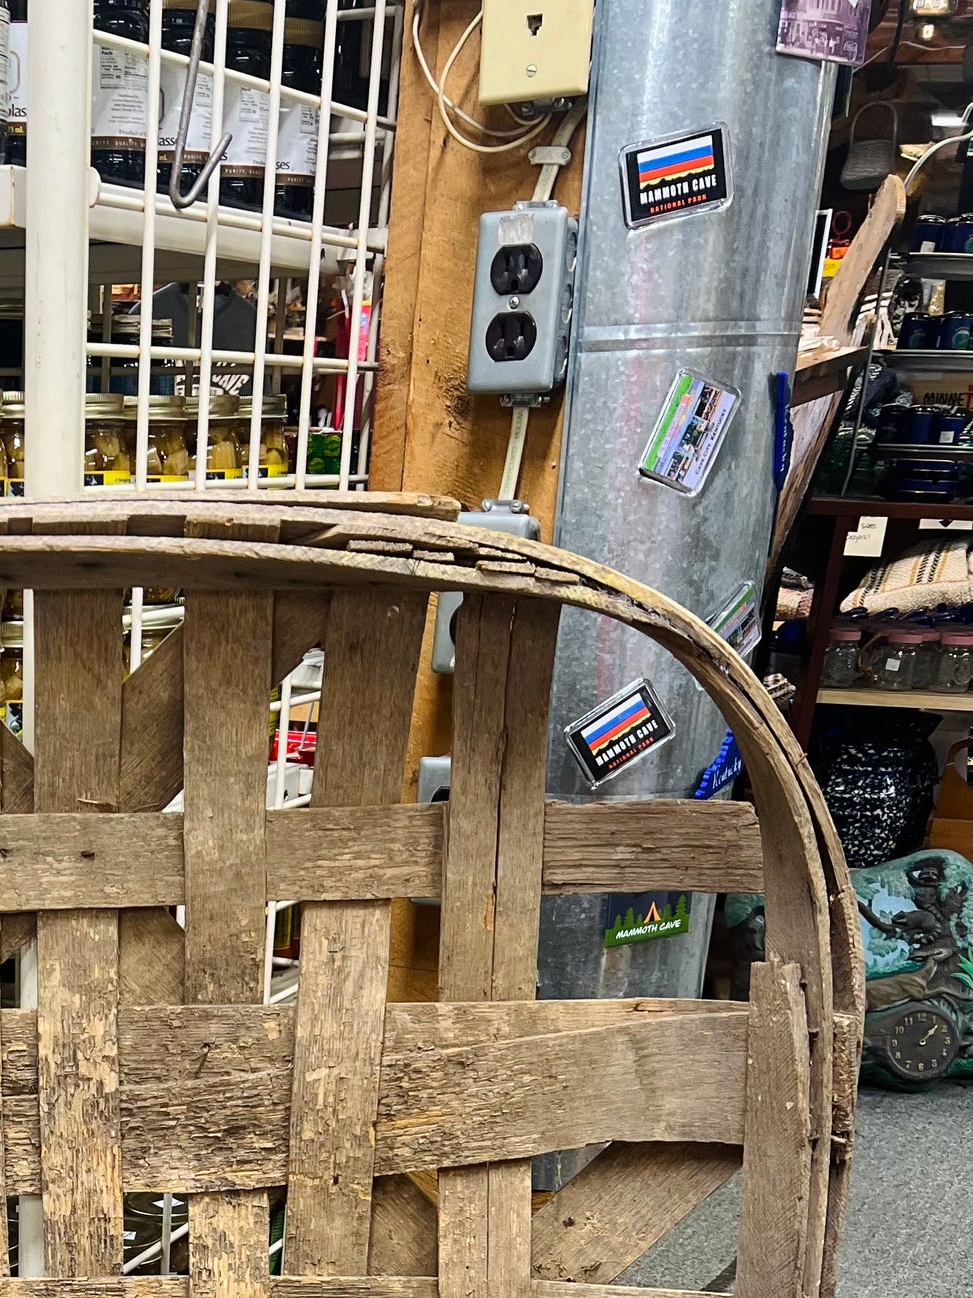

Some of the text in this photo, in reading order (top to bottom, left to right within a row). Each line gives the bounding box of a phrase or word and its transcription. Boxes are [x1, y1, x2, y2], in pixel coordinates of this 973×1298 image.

[639, 174, 717, 205] MAMMOTH CAVE
[650, 193, 707, 214] NATIONAL PARK
[710, 408, 727, 441] KENTUCKY
[595, 719, 659, 767] MAMMOTH CAVE
[712, 756, 742, 790] Kentucky
[615, 918, 682, 940] MAMMOTH CAVE
